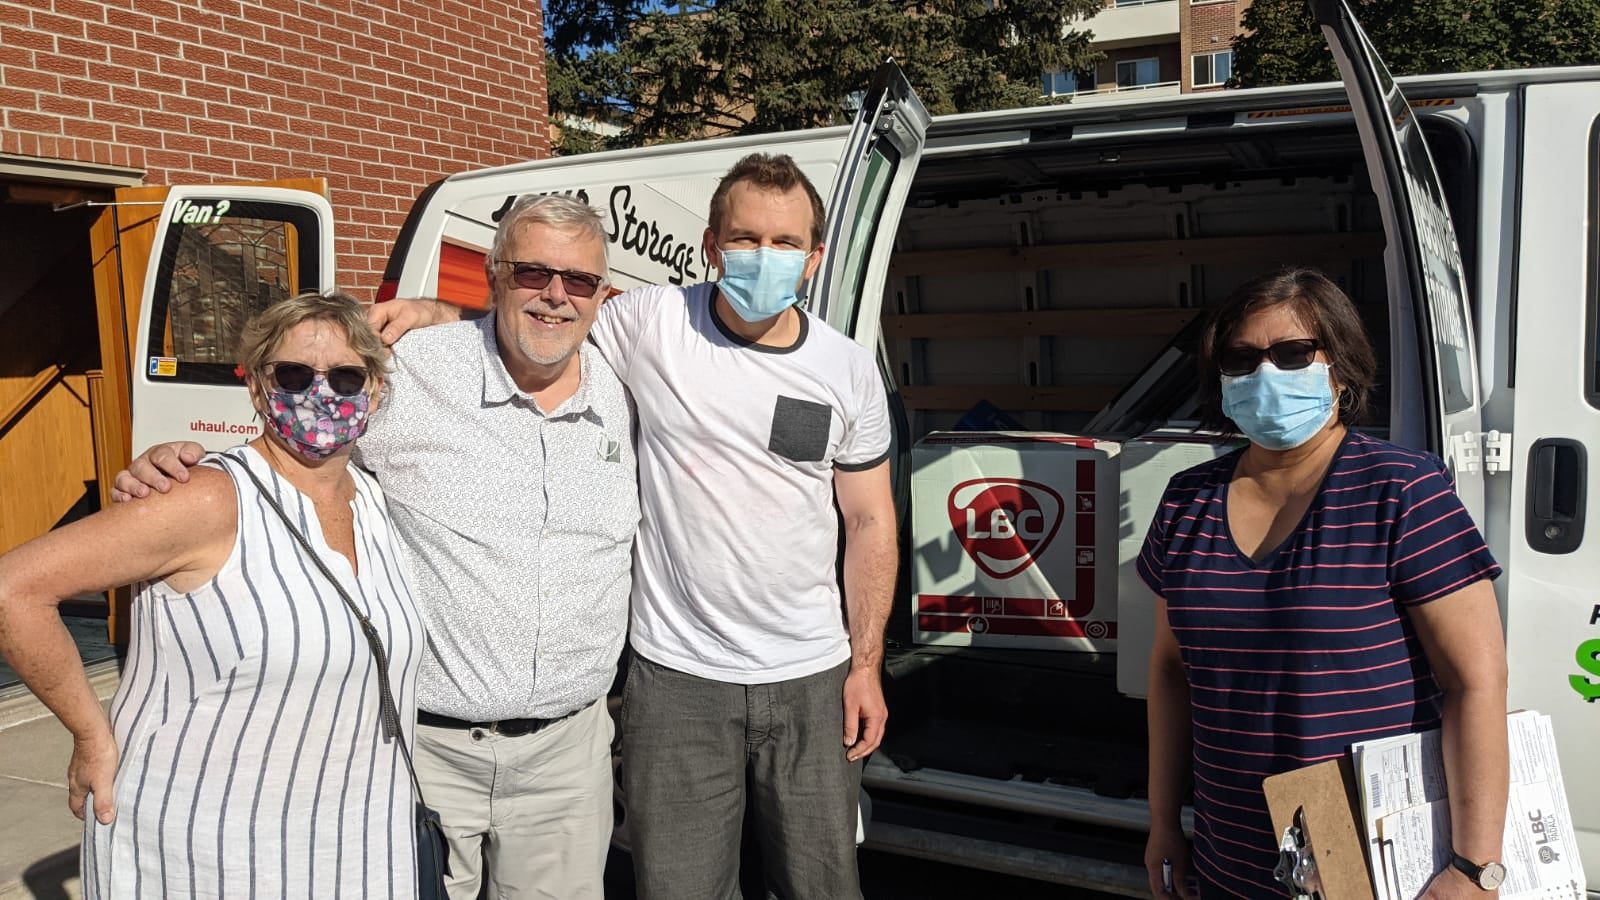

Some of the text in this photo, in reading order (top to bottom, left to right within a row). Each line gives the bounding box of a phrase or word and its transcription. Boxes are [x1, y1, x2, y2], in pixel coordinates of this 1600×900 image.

[172, 200, 231, 224] Van?
[608, 185, 697, 285] Storage
[190, 420, 258, 435] uhaul.com
[966, 508, 1044, 540] LBC
[1528, 808, 1548, 845] LBC
[1547, 813, 1560, 842] PADALA
